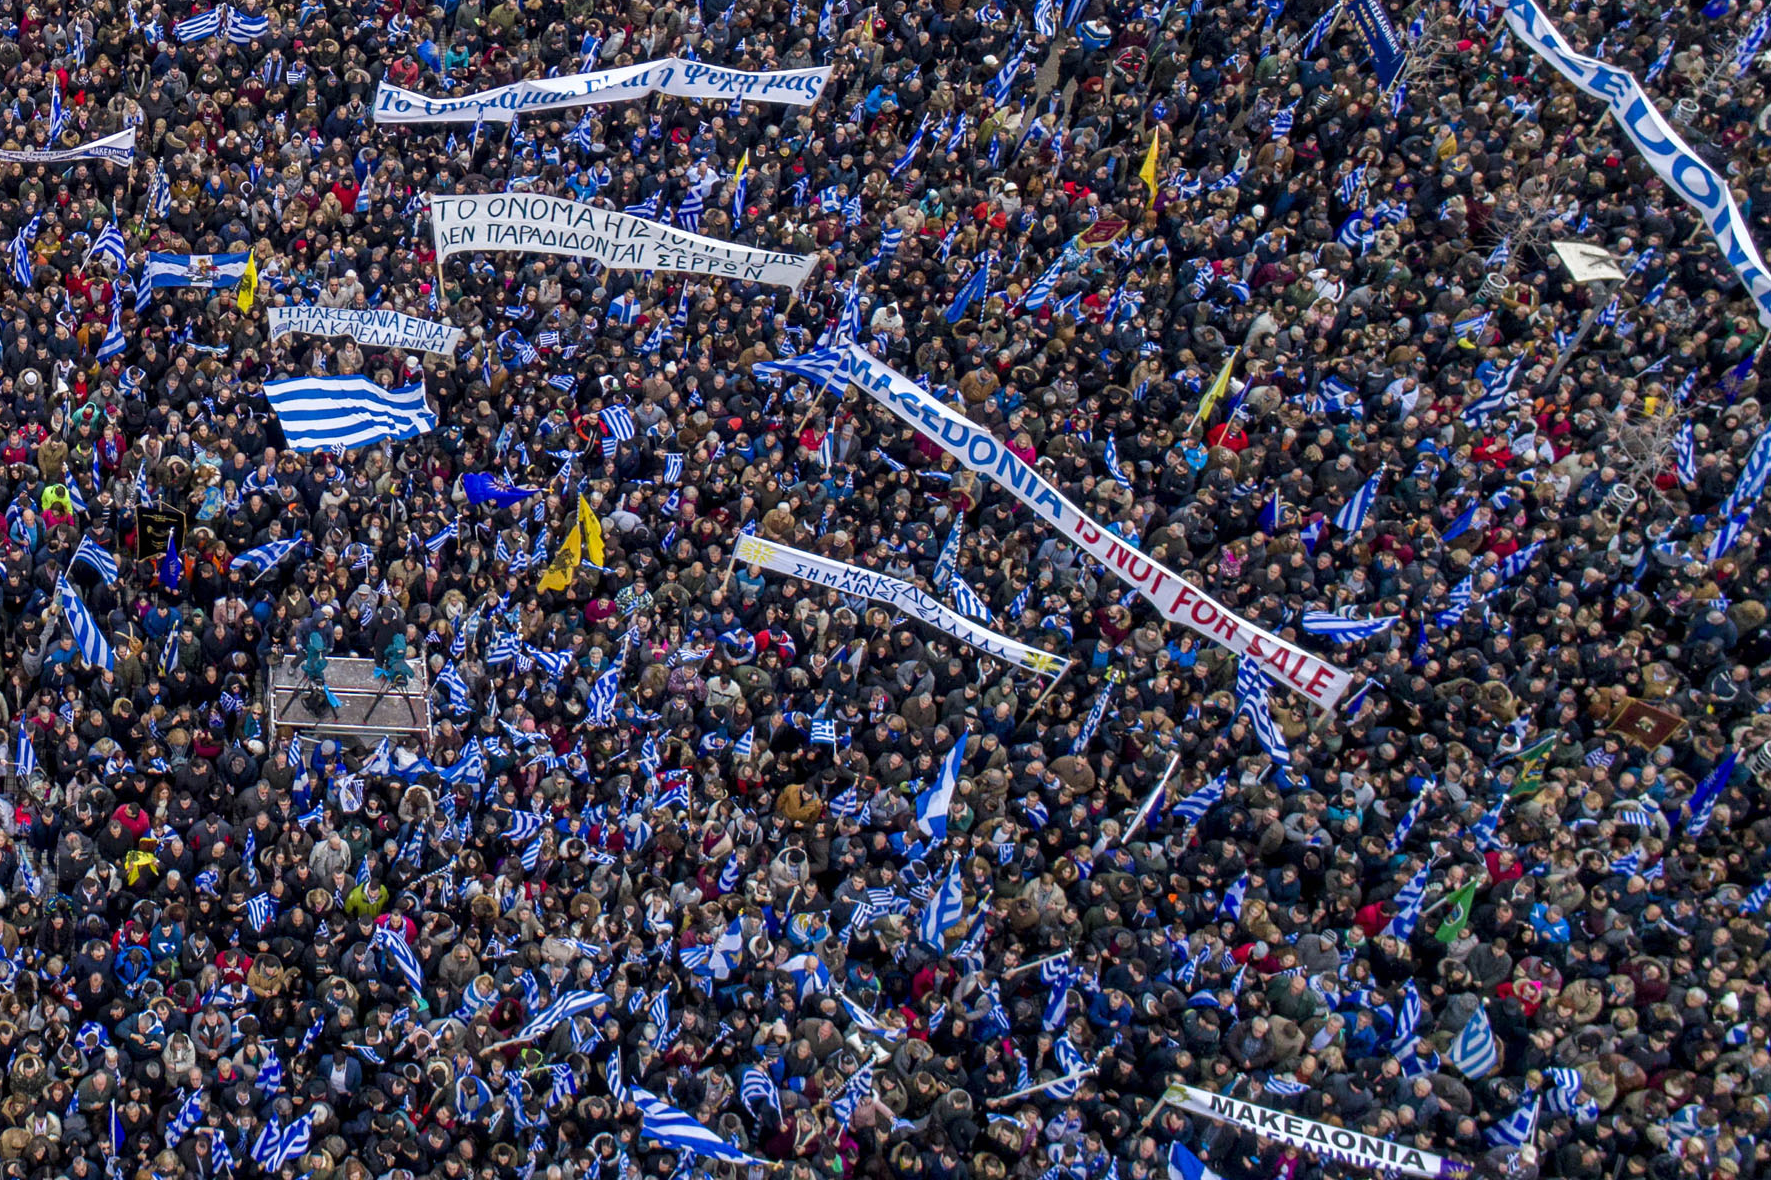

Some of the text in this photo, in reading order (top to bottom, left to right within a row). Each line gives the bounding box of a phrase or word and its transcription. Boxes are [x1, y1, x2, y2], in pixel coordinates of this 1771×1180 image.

[379, 86, 412, 114] Το
[762, 70, 822, 100] μας
[434, 197, 477, 221] ΤΟ
[487, 196, 596, 231] ΟΝΟΜΑ
[604, 212, 623, 239] Η
[441, 224, 475, 255] ΔΕΝ
[486, 222, 645, 264] ΠΑΡΑΔΙΔΟΝΤΑΙ
[656, 253, 764, 282] ΣΕΡΡΩΝ
[279, 307, 452, 340] Η ΜΑΚΕΔΟΝΙΑ ΕΙΝΑΙ
[287, 319, 446, 353] ΜΙΑ ΚΑΙ ΕΛΛΗΝΙΚΗ
[848, 349, 1064, 520] MACEDONIA
[792, 562, 899, 603] ΣΗΜΑΙΝΕΙ
[1073, 515, 1337, 700] IS NOT FOR SALE
[1209, 1094, 1428, 1172] ΜΑΚΕΔΟΝΙΑ
